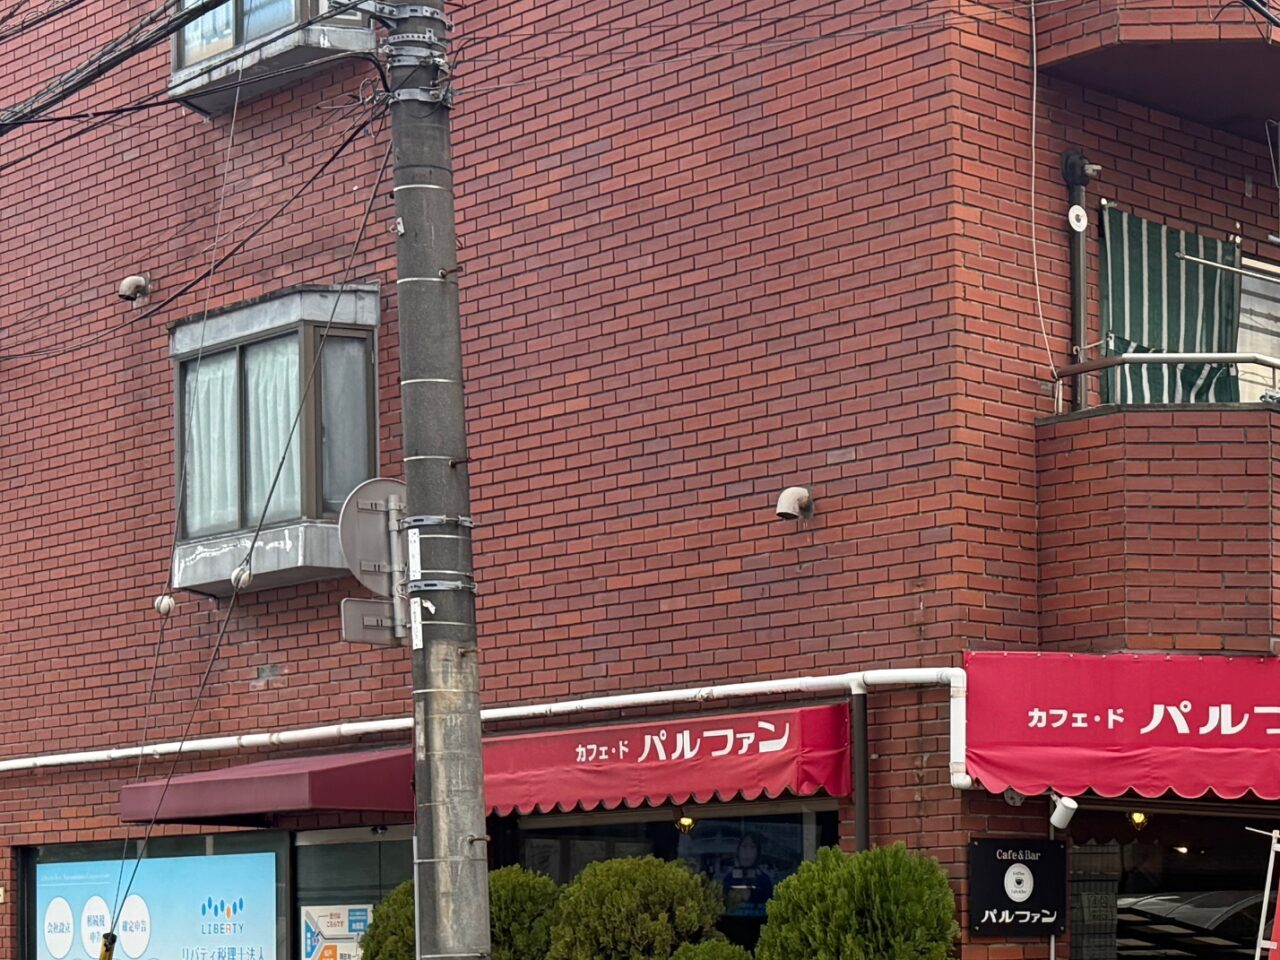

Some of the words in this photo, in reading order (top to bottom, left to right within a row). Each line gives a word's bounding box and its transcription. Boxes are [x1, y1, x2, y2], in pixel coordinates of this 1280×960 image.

[1027, 708, 1124, 729] カフェ・ド
[576, 740, 629, 762] カフェ・ド
[637, 721, 790, 762] パルファン
[980, 909, 1057, 923] パルファン
[201, 923, 244, 935] LIBERTY
